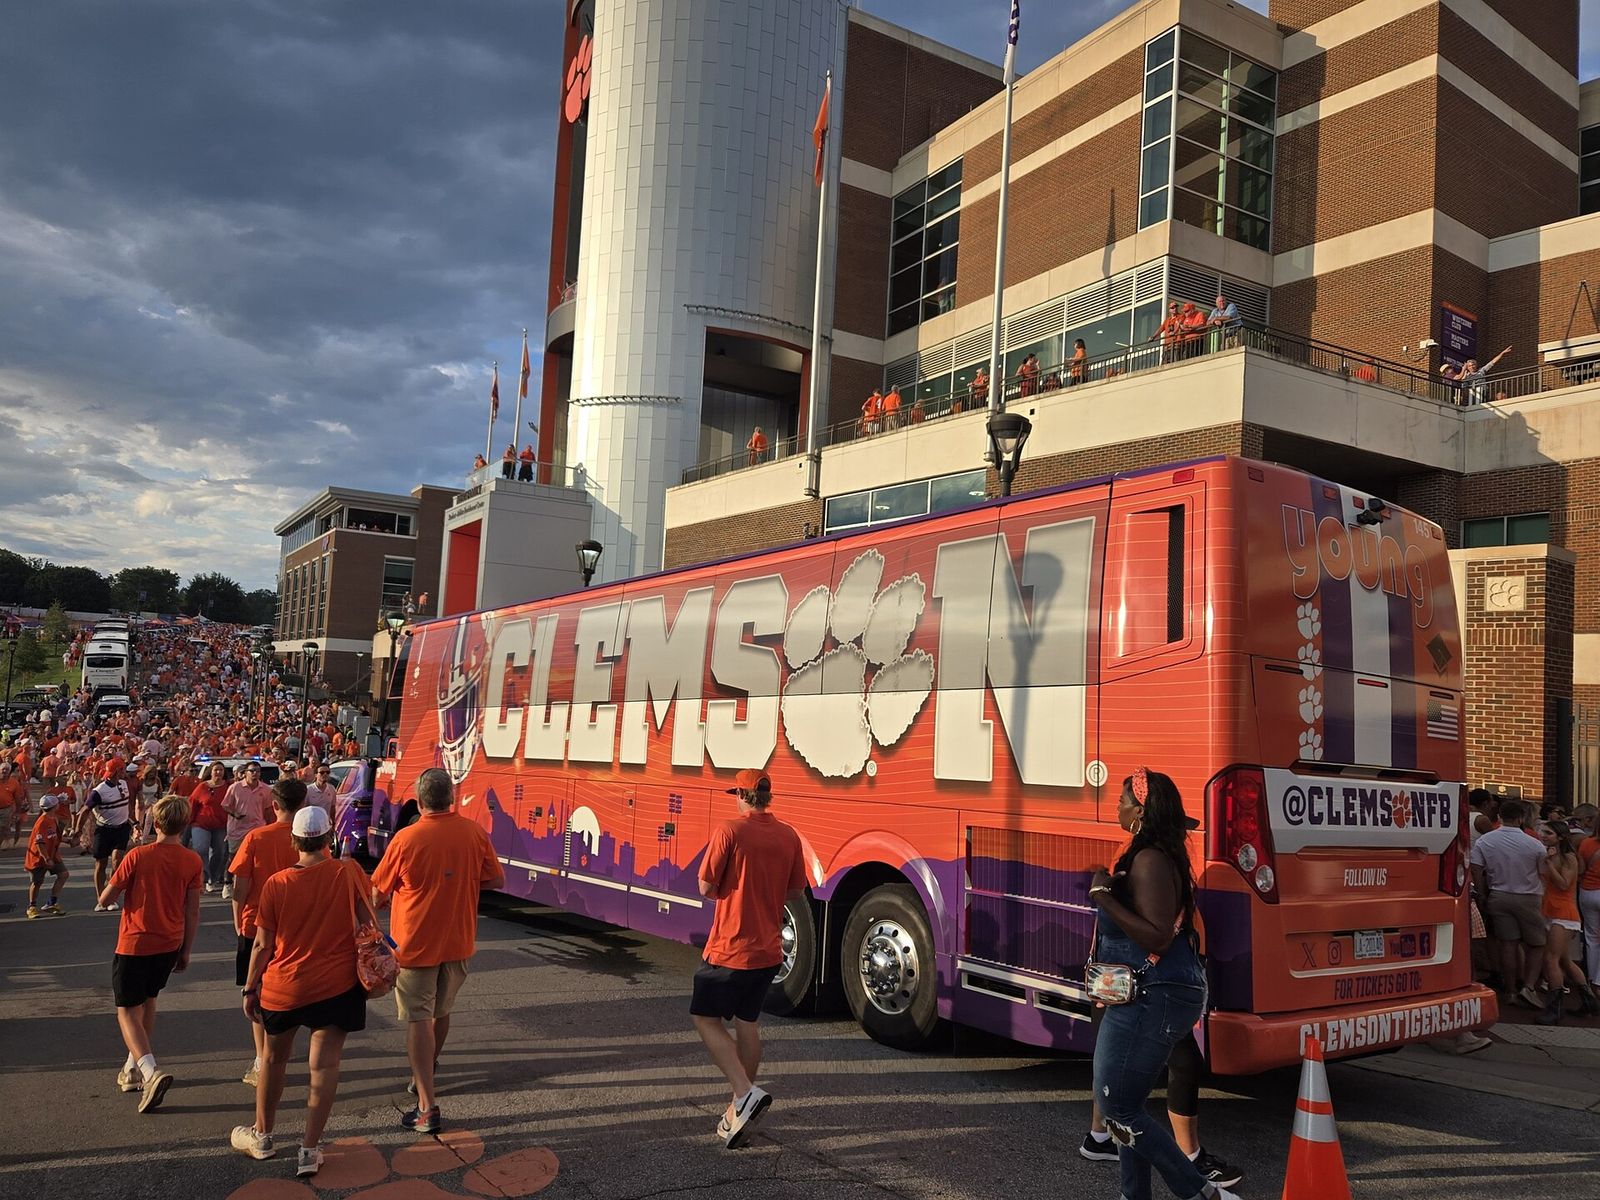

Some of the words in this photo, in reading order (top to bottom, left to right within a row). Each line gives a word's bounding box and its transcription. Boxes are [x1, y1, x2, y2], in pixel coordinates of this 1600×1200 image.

[1281, 504, 1433, 629] young
[1343, 868, 1375, 887] FOLLOW
[1376, 867, 1388, 886] US
[1335, 979, 1353, 1000] FOR
[1356, 975, 1394, 998] TICKETS
[1396, 972, 1408, 992] GO
